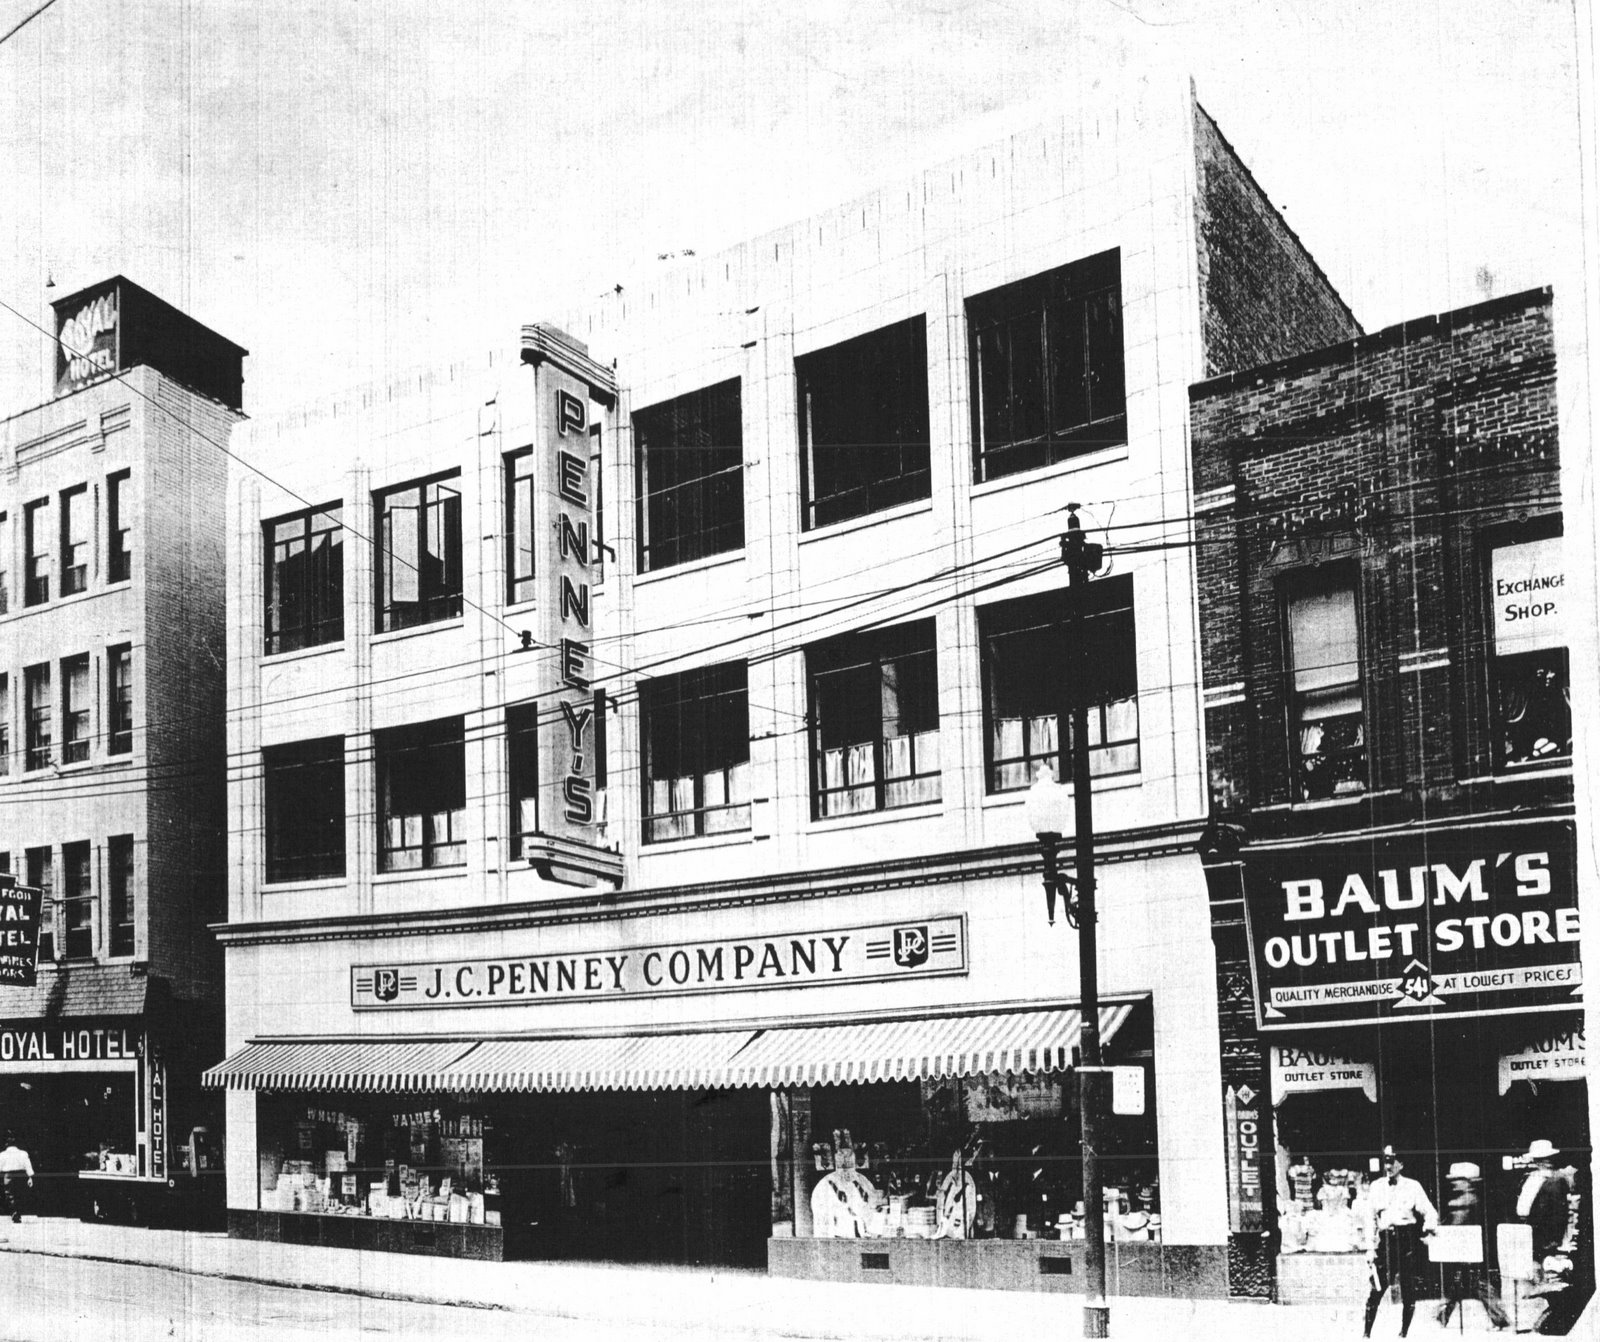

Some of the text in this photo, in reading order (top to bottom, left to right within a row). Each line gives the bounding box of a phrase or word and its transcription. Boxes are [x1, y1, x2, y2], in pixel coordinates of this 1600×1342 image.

[70, 348, 115, 381] HOTEL
[1496, 573, 1565, 597] EXCHANGE
[556, 388, 593, 826] PENNEY'S
[1504, 602, 1558, 622] SHOP.
[1281, 852, 1551, 921] BAUM'S
[0, 904, 30, 921] AL
[1264, 907, 1582, 969] OUTLET STORE
[642, 936, 851, 987] COMPANY
[1275, 982, 1394, 1002] QUALITY MERCHANDISE
[1443, 968, 1573, 989] AT LOWEST PRICES
[63, 1029, 136, 1059] HOTEL
[1284, 1070, 1364, 1082] OUTLET STORE
[1510, 1060, 1549, 1072] OUTLET
[153, 1108, 162, 1178] HOTEL
[1240, 1121, 1260, 1197] OUTLET
